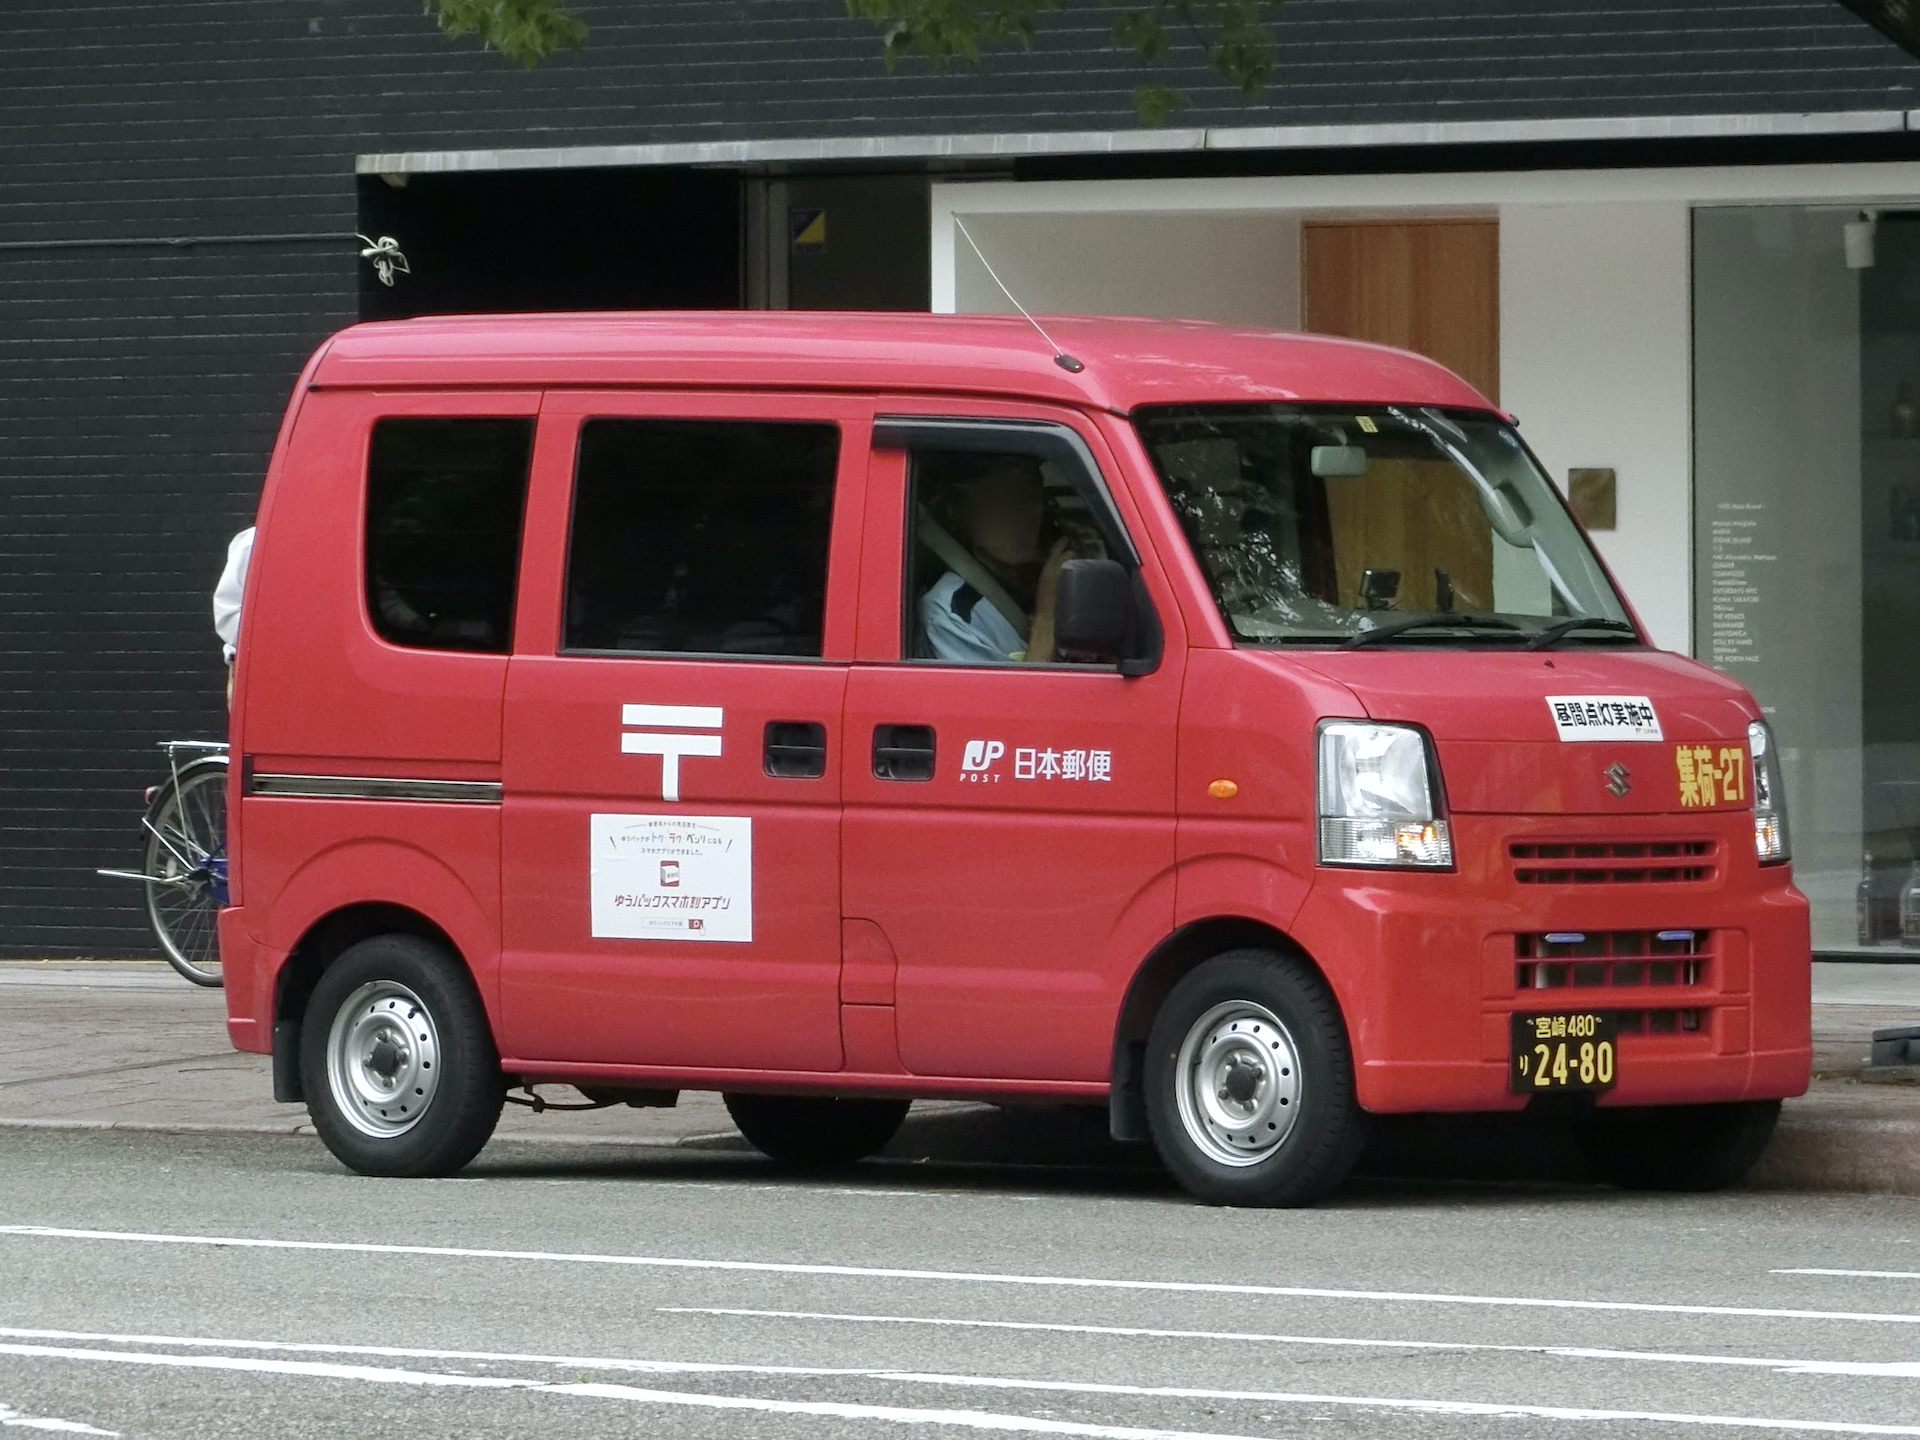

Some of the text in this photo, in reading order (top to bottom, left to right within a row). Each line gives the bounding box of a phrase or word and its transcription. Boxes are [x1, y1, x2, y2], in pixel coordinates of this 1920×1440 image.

[1553, 701, 1654, 727] 昼間点灯実施中
[1014, 747, 1112, 782] 日本郵便
[959, 773, 1000, 783] POST
[614, 893, 731, 910] ゆうパックスマホ割アプリ
[1534, 1041, 1613, 1087] 24-80
